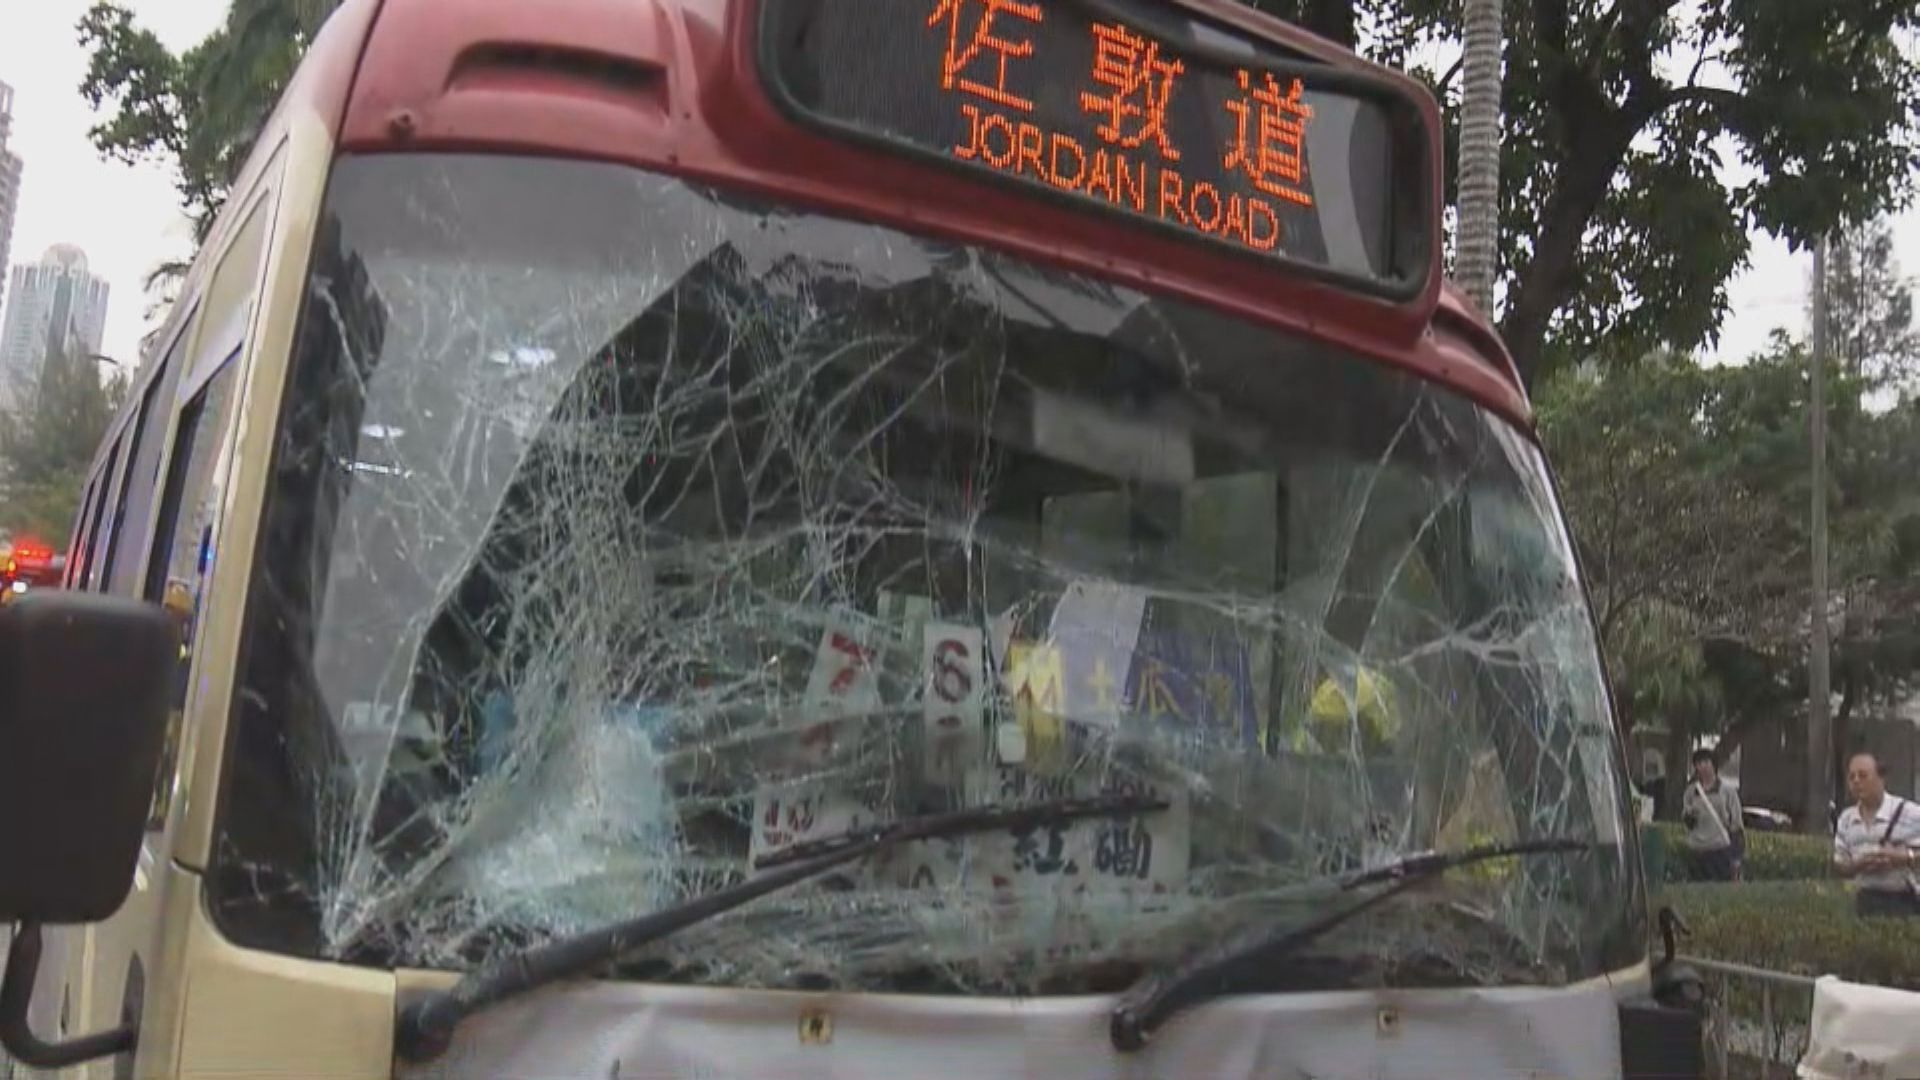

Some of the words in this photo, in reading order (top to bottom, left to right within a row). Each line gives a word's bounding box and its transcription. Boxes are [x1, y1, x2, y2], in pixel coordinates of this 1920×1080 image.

[927, 0, 1314, 206] 佐敦道
[954, 104, 1146, 212] JORDAN
[1158, 171, 1280, 252] ROAD
[932, 638, 972, 703] 6
